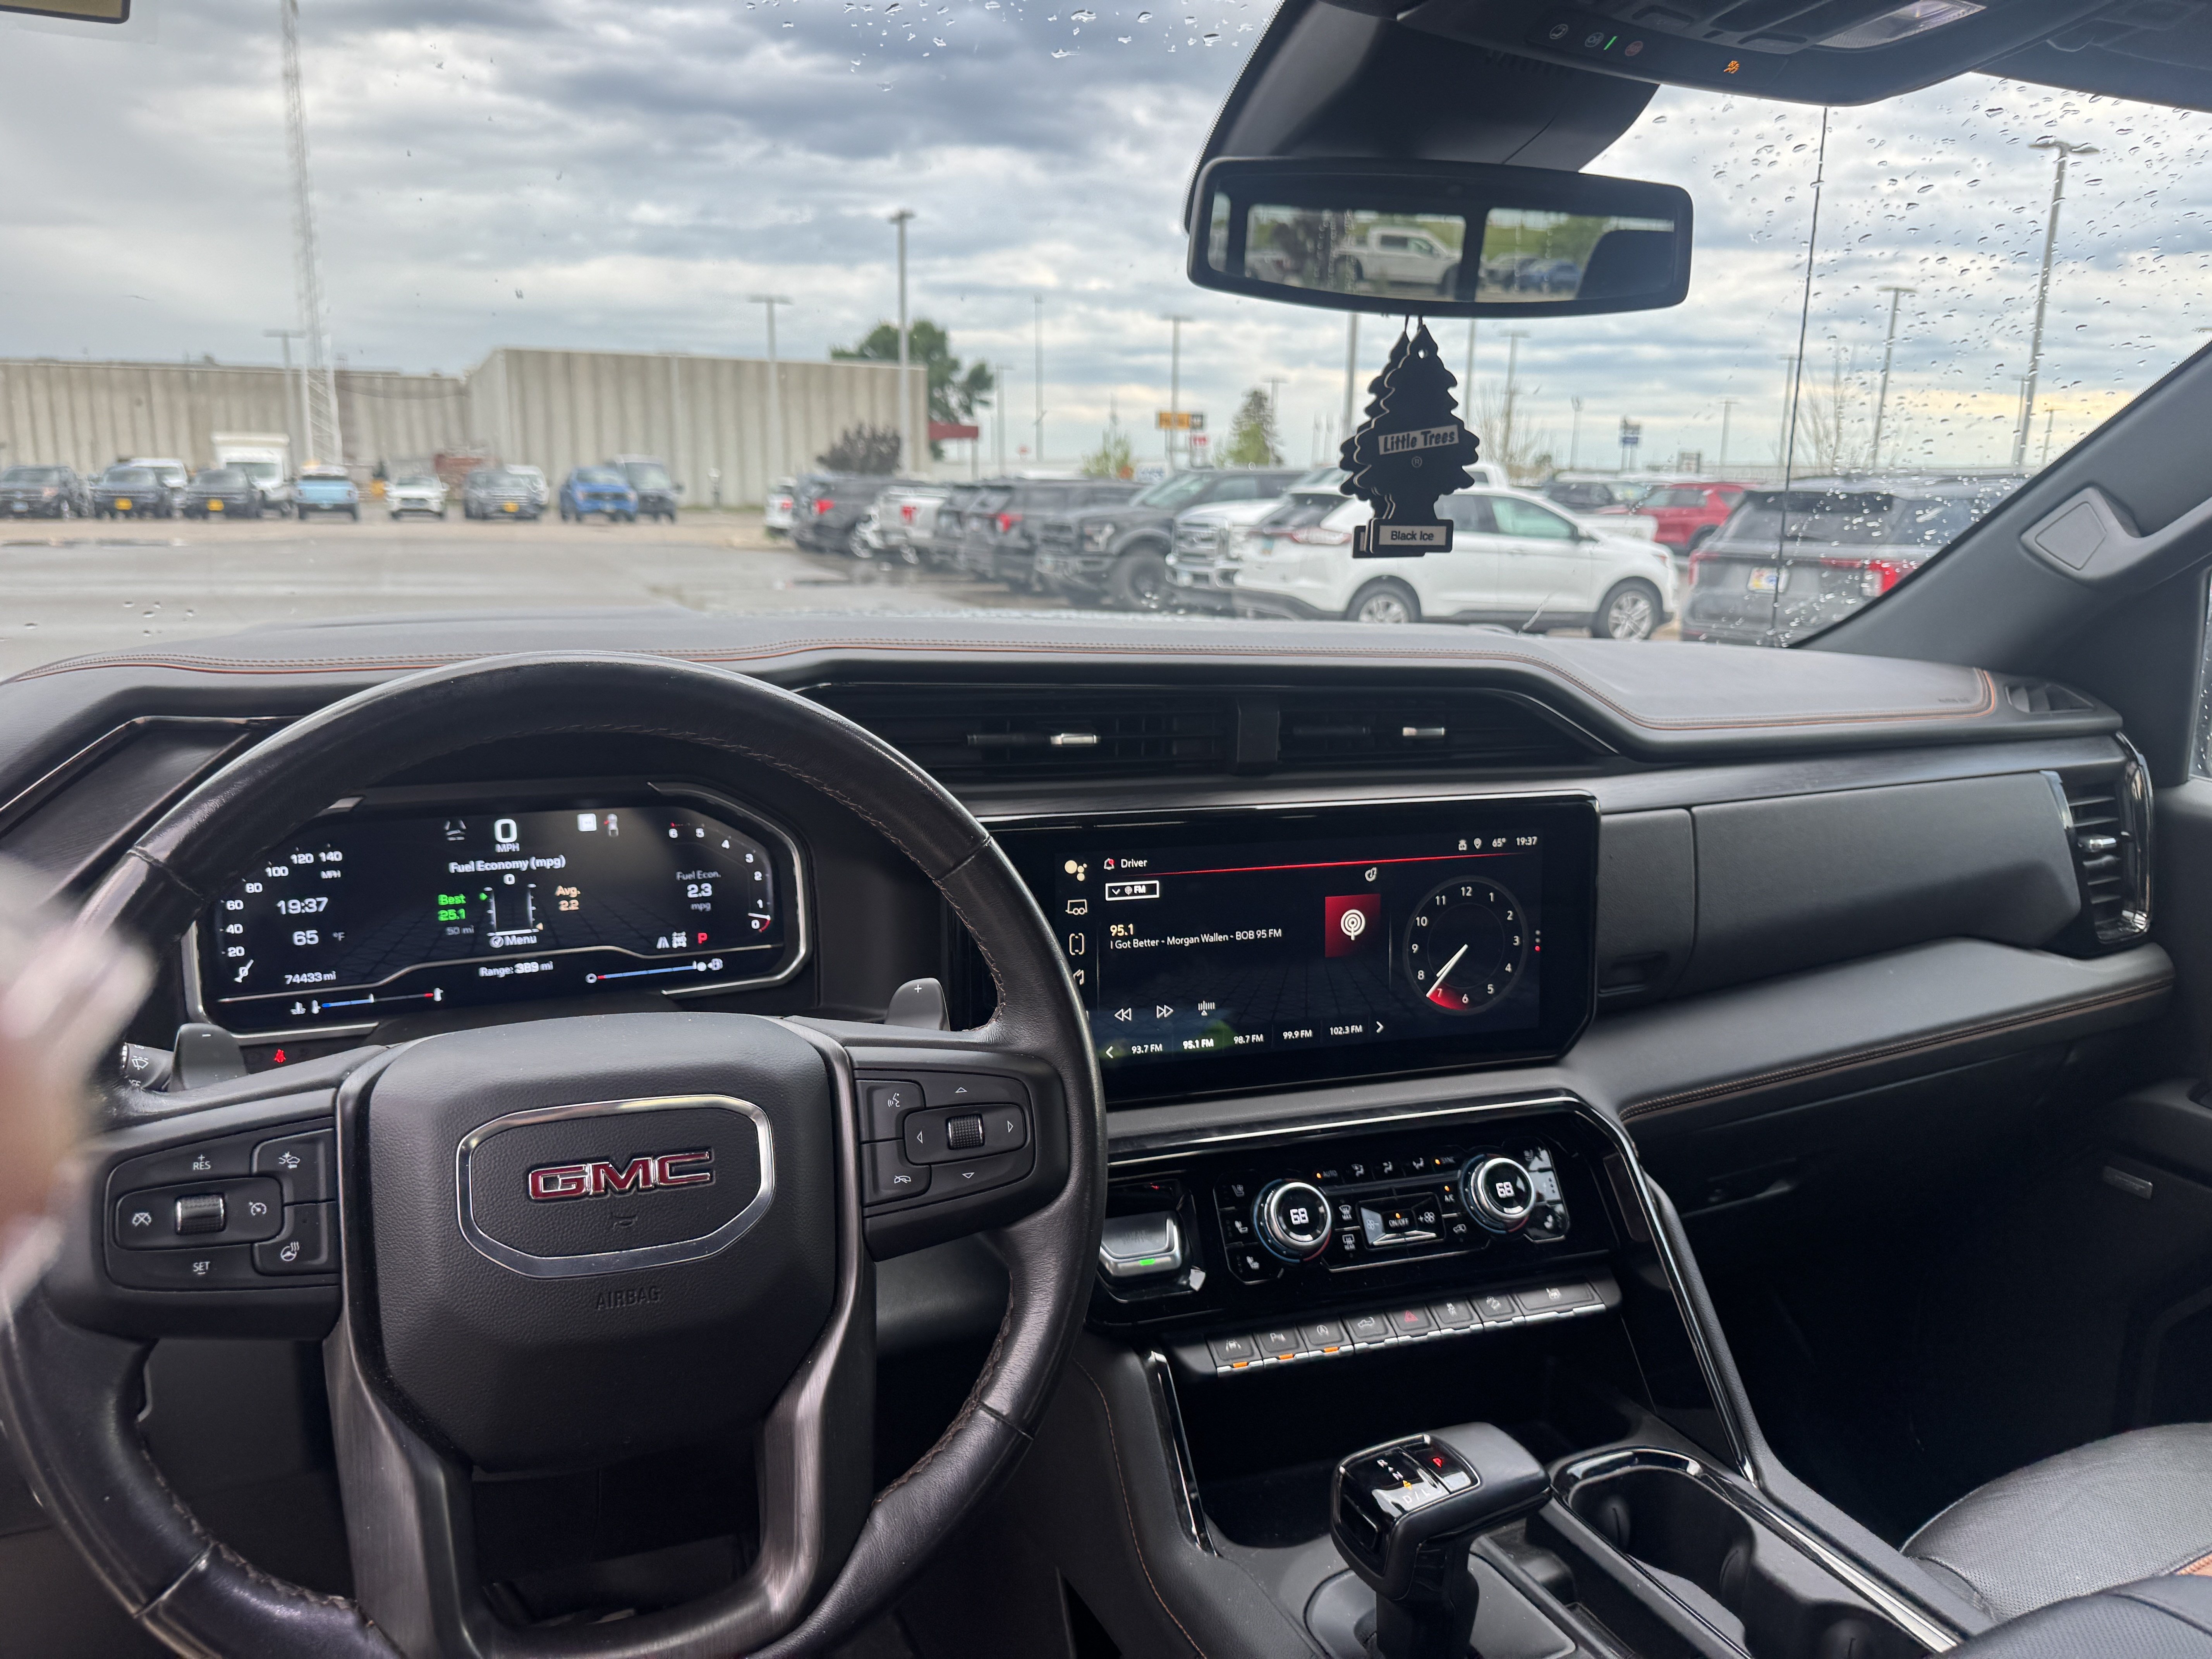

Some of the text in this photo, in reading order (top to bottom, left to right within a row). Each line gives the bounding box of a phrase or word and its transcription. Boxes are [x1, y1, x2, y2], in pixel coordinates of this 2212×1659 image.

[1384, 430, 1455, 452] Little Trees
[1391, 531, 1434, 541] Black Ice
[495, 819, 517, 843] 0
[669, 829, 678, 838] 6
[696, 828, 704, 838] 5
[721, 840, 730, 848] 4
[1492, 836, 1537, 847] 65° 19:37
[496, 843, 519, 852] MPH
[290, 853, 314, 864] 120
[319, 851, 342, 862] 140
[746, 854, 753, 863] 3
[449, 855, 566, 873] Fuel Economy (mpg)
[1121, 859, 1147, 868] Driver
[265, 866, 289, 877] 100
[321, 870, 341, 878] MPH
[676, 871, 721, 880] Fuel Econ.
[754, 871, 762, 881] 2
[246, 883, 263, 893] 80
[555, 886, 580, 897] Avg.
[687, 883, 712, 898] 2.3
[1133, 884, 1146, 893] FM
[1461, 886, 1472, 896] 12
[438, 894, 466, 905] Best
[1436, 895, 1445, 905] 11
[1489, 893, 1493, 901] 1
[227, 900, 244, 910] 60
[277, 897, 328, 914] 19:37
[691, 903, 711, 911] mpg
[757, 900, 763, 908] 1
[438, 908, 465, 921] 25.1
[1507, 910, 1513, 920] 2
[751, 919, 760, 929] 0
[1416, 917, 1427, 926] 10
[226, 924, 243, 934] 40
[462, 925, 474, 934] mi
[1110, 924, 1133, 936] 95.1
[293, 930, 318, 945] 65
[503, 934, 537, 945] Menu
[698, 933, 707, 944] P
[1111, 941, 1113, 949] I
[1115, 940, 1131, 949] Got
[1133, 939, 1159, 948] Better
[1167, 936, 1199, 946] Morgan
[1201, 933, 1228, 942] Wallen
[1236, 931, 1254, 940] BOB
[1256, 930, 1267, 938] 95
[1269, 929, 1281, 937] FM
[1513, 936, 1520, 945] 3
[228, 946, 244, 957] 20
[1412, 944, 1419, 953] 9
[479, 967, 514, 977] Range:
[539, 961, 553, 970] mi
[1505, 963, 1511, 972] 4
[285, 971, 336, 984] 74433 mi
[1418, 970, 1424, 980] 8
[1437, 988, 1443, 997] 7
[1487, 984, 1494, 994] 5
[1462, 994, 1468, 1003] 6
[1283, 1030, 1312, 1039] 99.9 FM
[1330, 1026, 1350, 1035] 102.3
[1183, 1038, 1214, 1049] 95.1 FM
[1234, 1034, 1263, 1044] 98.7 FM
[1132, 1044, 1162, 1054] 93.7 FM
[193, 1161, 211, 1170] RES
[529, 1150, 711, 1200] GMC
[1290, 1208, 1309, 1225] 68
[193, 1261, 210, 1271] SET
[596, 1286, 661, 1310] AIRBAG
[1377, 1460, 1388, 1468] R
